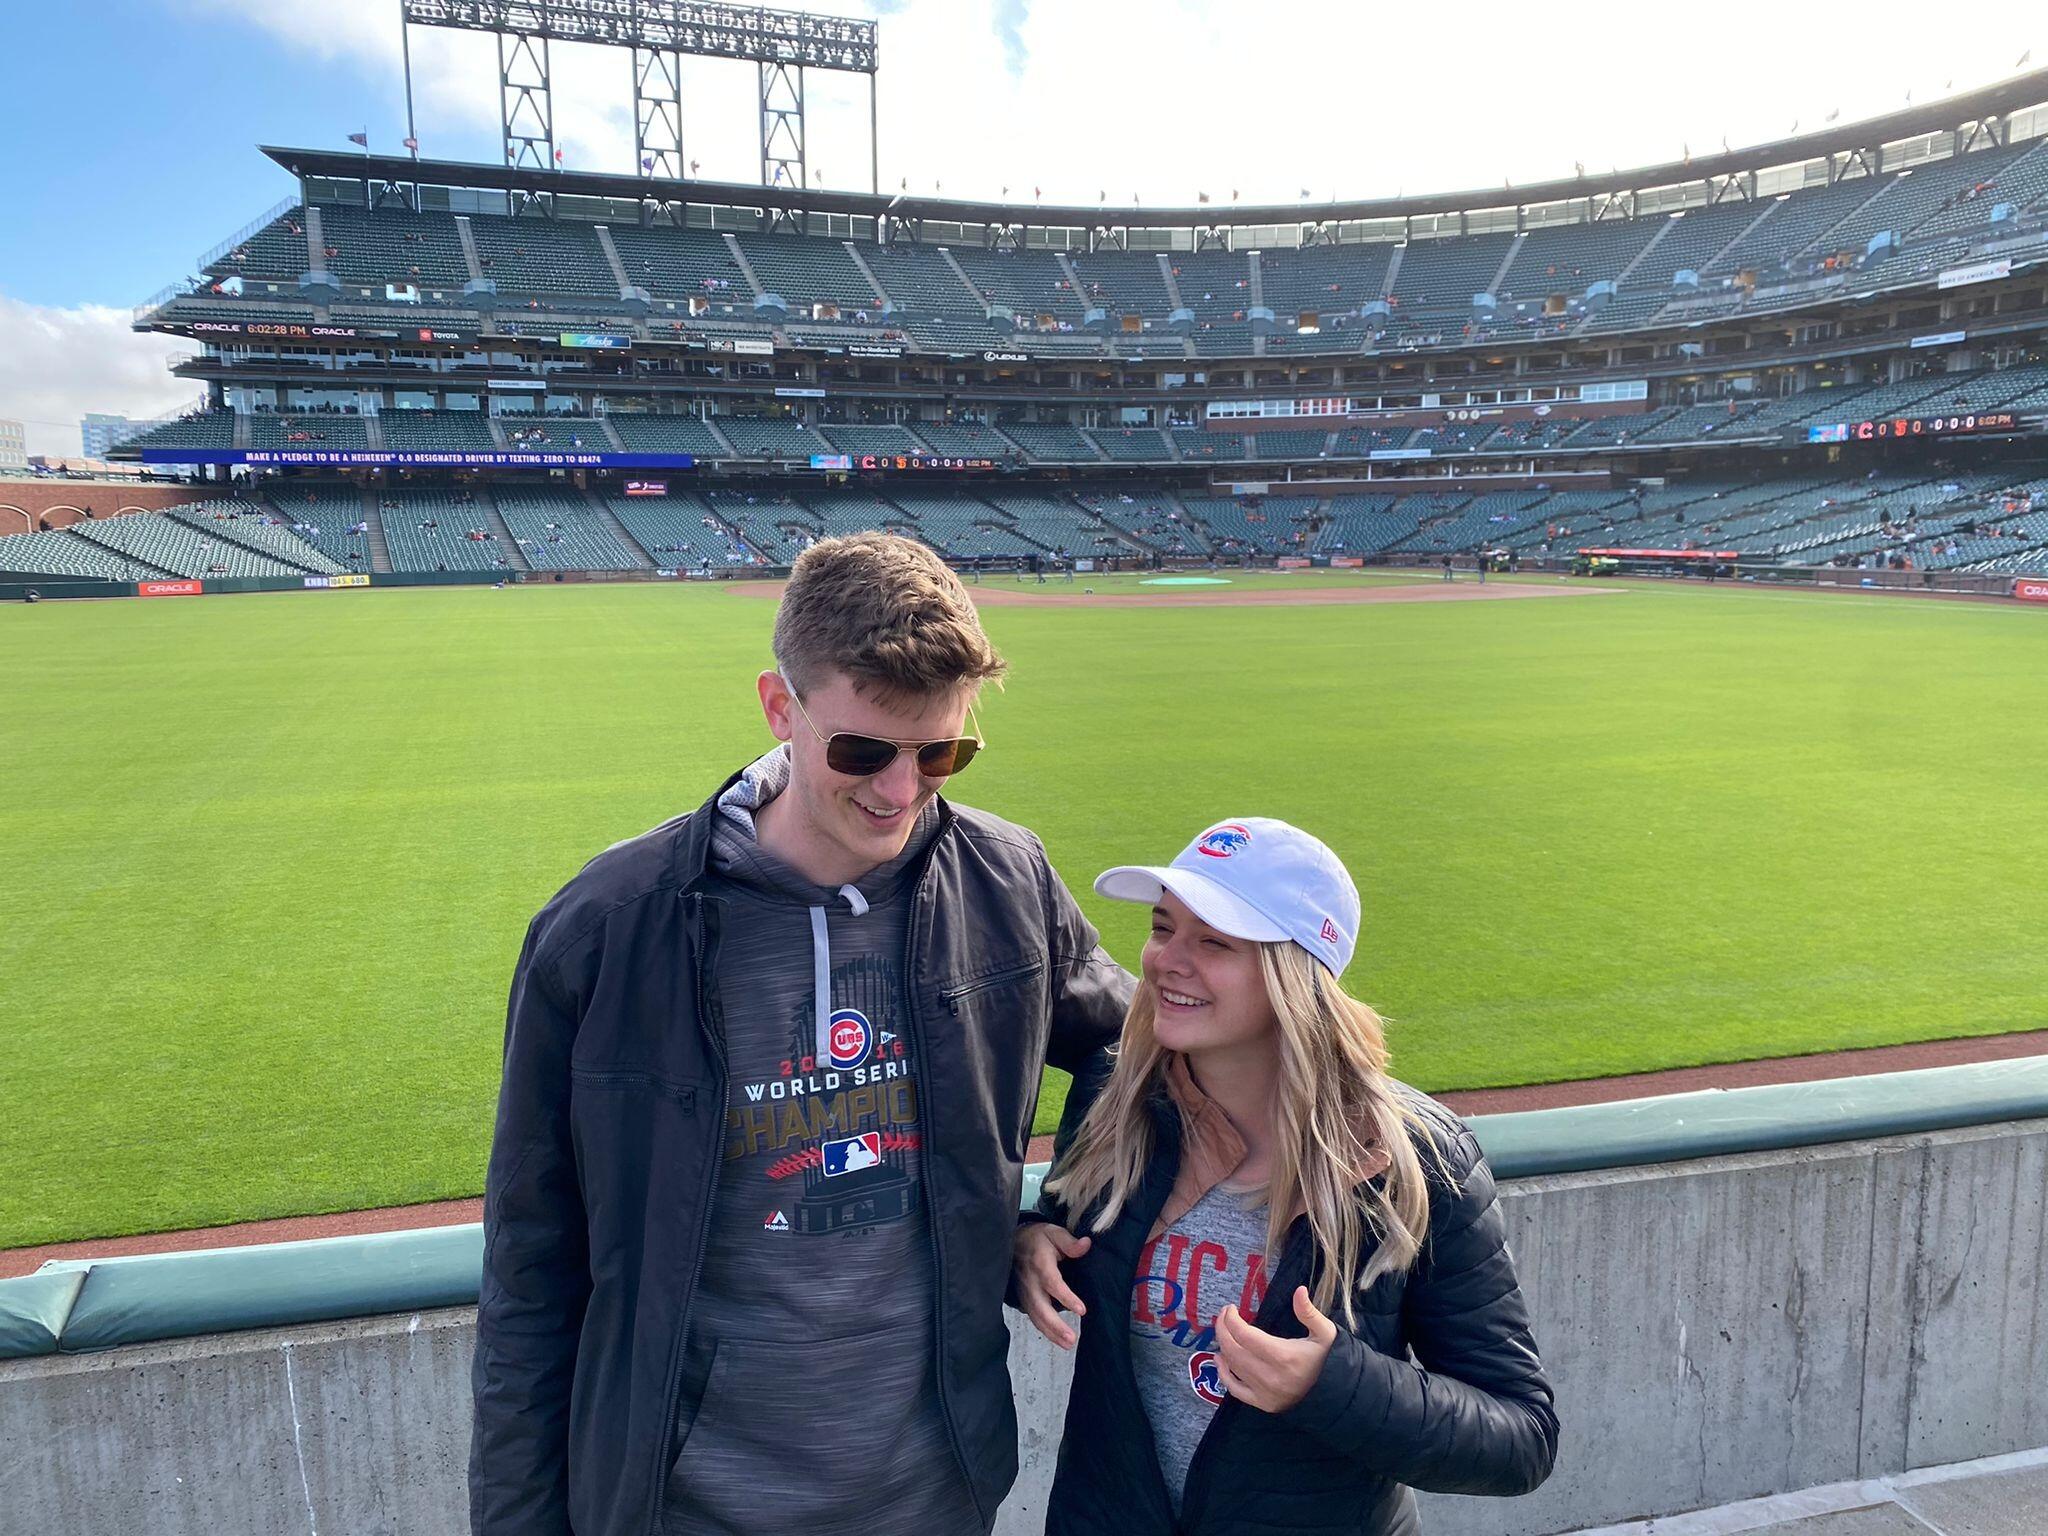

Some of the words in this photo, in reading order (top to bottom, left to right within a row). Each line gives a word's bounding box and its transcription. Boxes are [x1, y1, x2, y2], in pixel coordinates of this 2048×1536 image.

[194, 322, 240, 332] ORACLE
[247, 325, 287, 335] 6:02:28
[290, 326, 306, 335] PM
[312, 327, 355, 336] ORACLE
[433, 332, 459, 340] TOYOTA
[581, 334, 613, 346] Alaska
[1879, 423, 1887, 435] 0
[1912, 421, 1921, 433] 0
[1934, 419, 1943, 430] 0
[1950, 417, 1959, 429] 0
[1966, 416, 1975, 428] 0
[1978, 415, 1996, 426] 6:02
[1998, 414, 2011, 424] PM
[246, 452, 270, 462] MAKE
[273, 453, 280, 462] A
[282, 453, 313, 462] PLEDGE
[316, 453, 327, 462] TO
[330, 453, 340, 462] BE
[342, 453, 349, 462] A
[399, 453, 412, 463] 0.0
[415, 454, 463, 463] DESIGNATED
[465, 454, 494, 463] DRIVER
[496, 454, 506, 463] BY
[509, 454, 541, 464] TEXTING
[543, 454, 563, 463] ZERO
[565, 454, 576, 463] TO
[881, 457, 889, 468] 0
[912, 457, 919, 468] 0
[931, 458, 938, 467] 0
[944, 458, 951, 467] 0
[956, 458, 963, 467] 0
[981, 459, 991, 467] PM
[304, 577, 328, 587] KNBR
[352, 576, 365, 585] 680
[147, 583, 193, 593] ORACLE
[744, 1072, 840, 1102] WORLD
[854, 1059, 908, 1086] SERI
